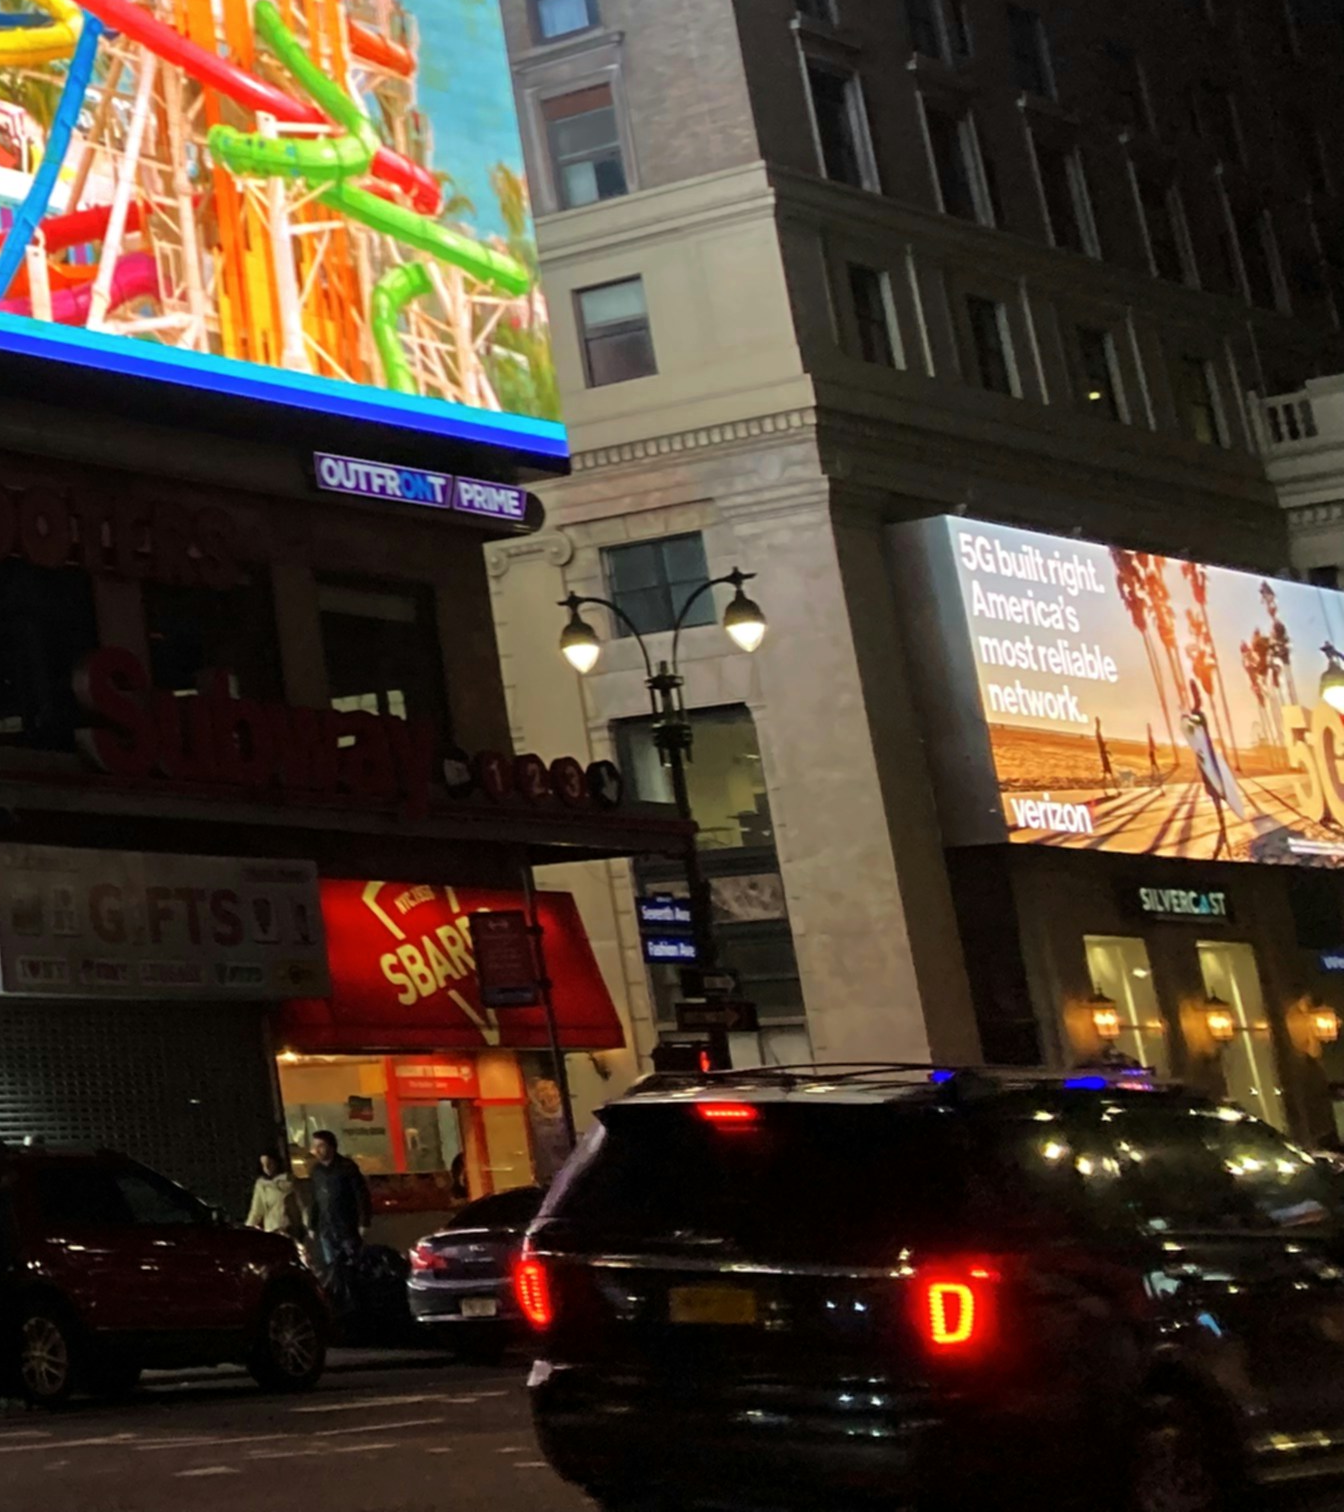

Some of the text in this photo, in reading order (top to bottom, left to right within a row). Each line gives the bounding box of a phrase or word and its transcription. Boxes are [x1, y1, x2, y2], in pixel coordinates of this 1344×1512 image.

[321, 458, 522, 515] OUTFRONT PRIME
[959, 533, 1105, 596] 5G built right.
[972, 580, 1080, 632] America's
[979, 635, 1119, 683] most reliable
[987, 680, 1089, 724] network.
[73, 646, 434, 820] Subway
[1011, 793, 1093, 834] verizon
[1139, 888, 1226, 915] SILVERCAST
